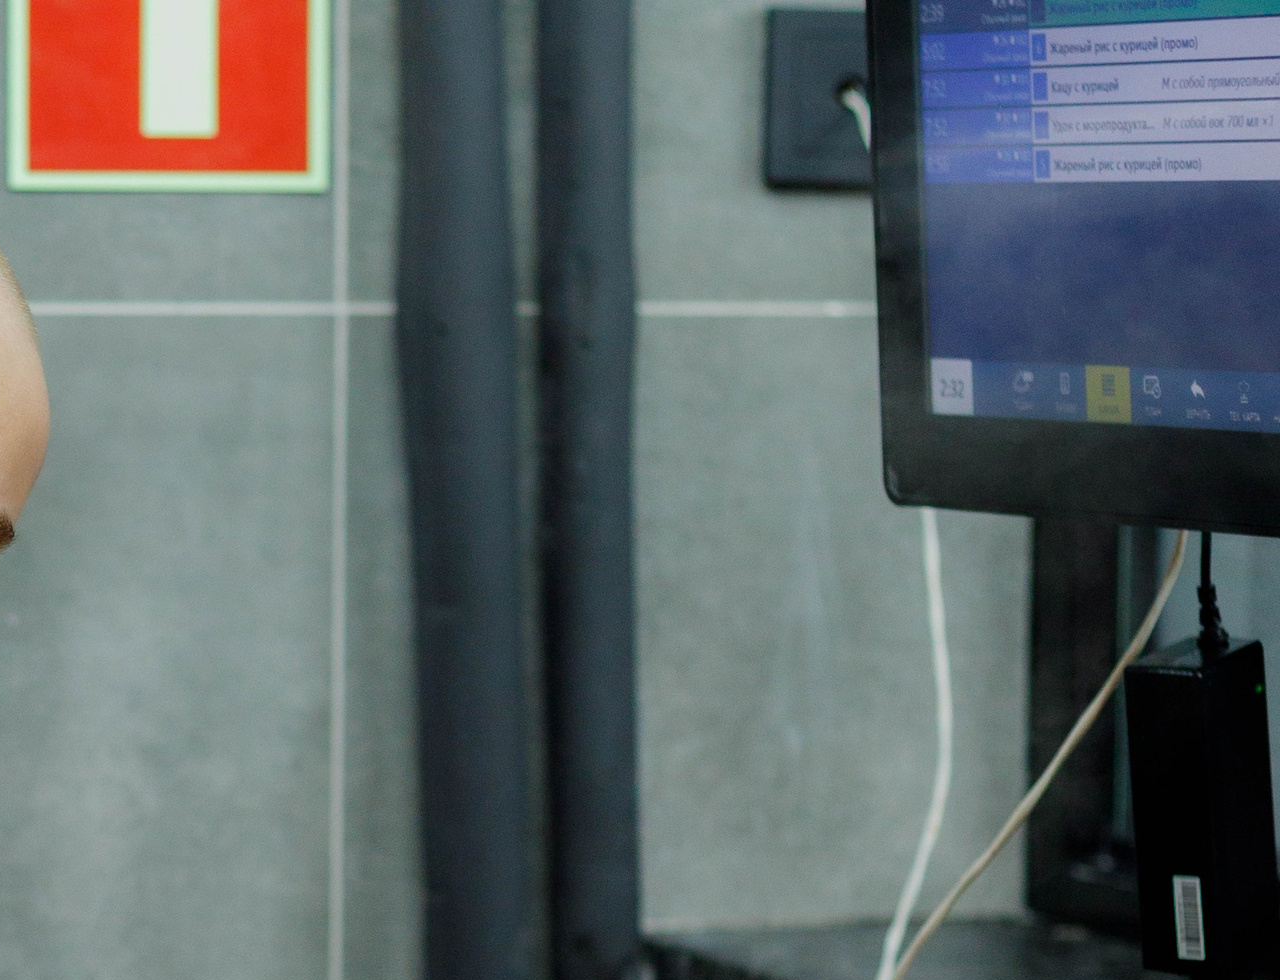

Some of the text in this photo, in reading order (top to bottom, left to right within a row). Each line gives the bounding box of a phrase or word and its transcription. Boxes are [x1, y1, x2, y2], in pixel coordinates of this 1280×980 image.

[1050, 40, 1092, 56] Жареный
[1095, 42, 1110, 55] рис
[1120, 37, 1158, 55] курицей
[1161, 36, 1198, 52] (промо)
[1051, 81, 1072, 95] Кацу
[1081, 78, 1119, 95] курицей
[1179, 75, 1205, 89] собой
[1180, 115, 1207, 129] собой
[1054, 157, 1096, 173] Жареный
[1098, 160, 1114, 173] рис
[1124, 157, 1162, 173] курицей
[1165, 157, 1202, 173] (промо)
